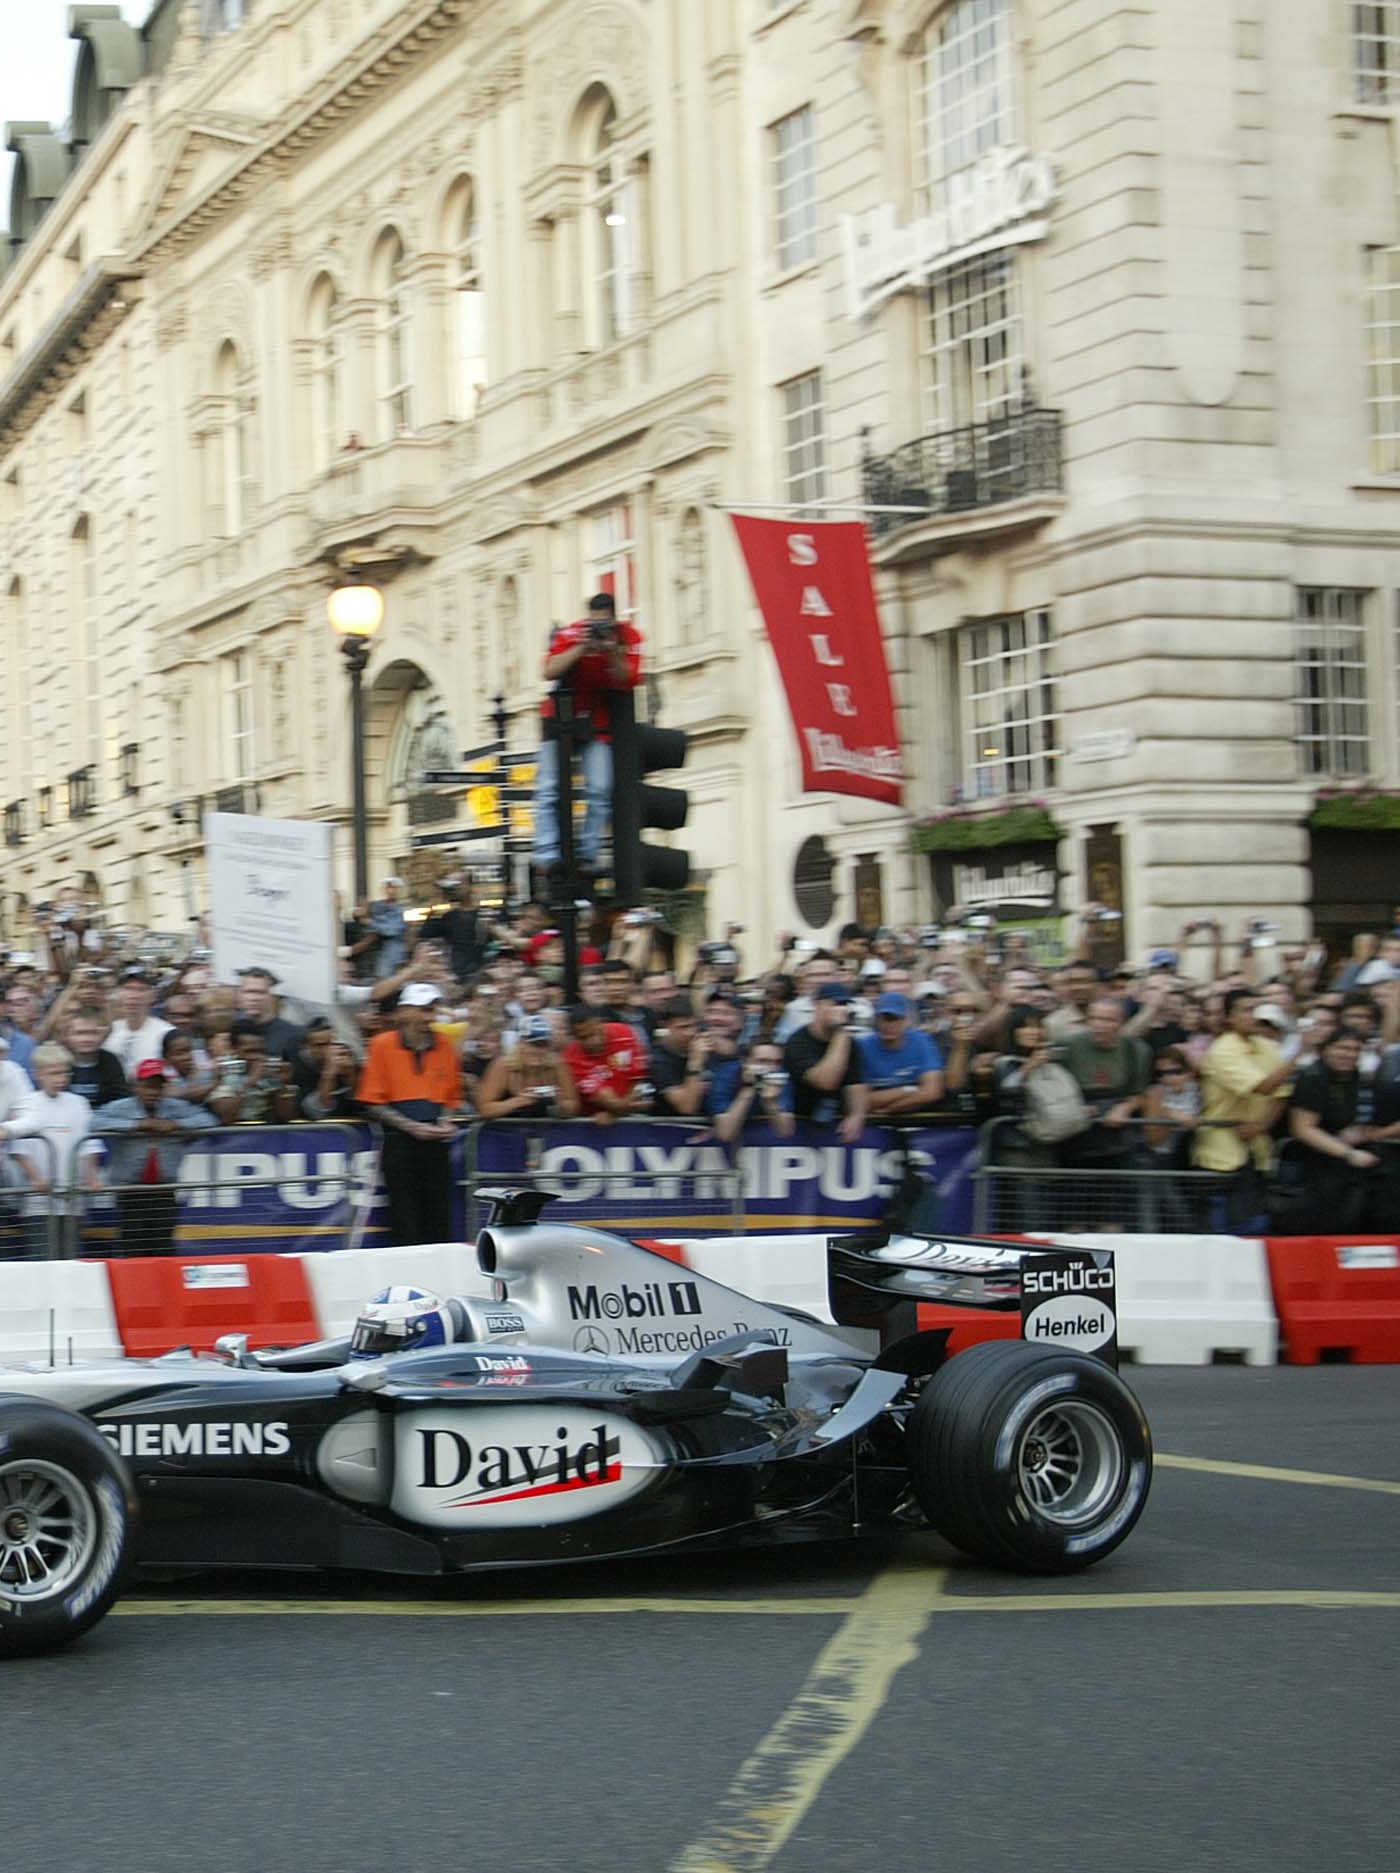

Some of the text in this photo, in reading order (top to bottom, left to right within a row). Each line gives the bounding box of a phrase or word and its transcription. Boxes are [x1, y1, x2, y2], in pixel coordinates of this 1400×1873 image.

[787, 534, 857, 716] SALE
[536, 1144, 937, 1202] OLYMPUS
[567, 1283, 665, 1320] Mobil
[488, 1317, 523, 1329] BOSS
[614, 1324, 727, 1354] Mercedes
[1035, 1314, 1105, 1338] Henkel
[474, 1356, 528, 1372] David
[98, 1422, 290, 1457] SIEMENS
[416, 1424, 610, 1490] David
